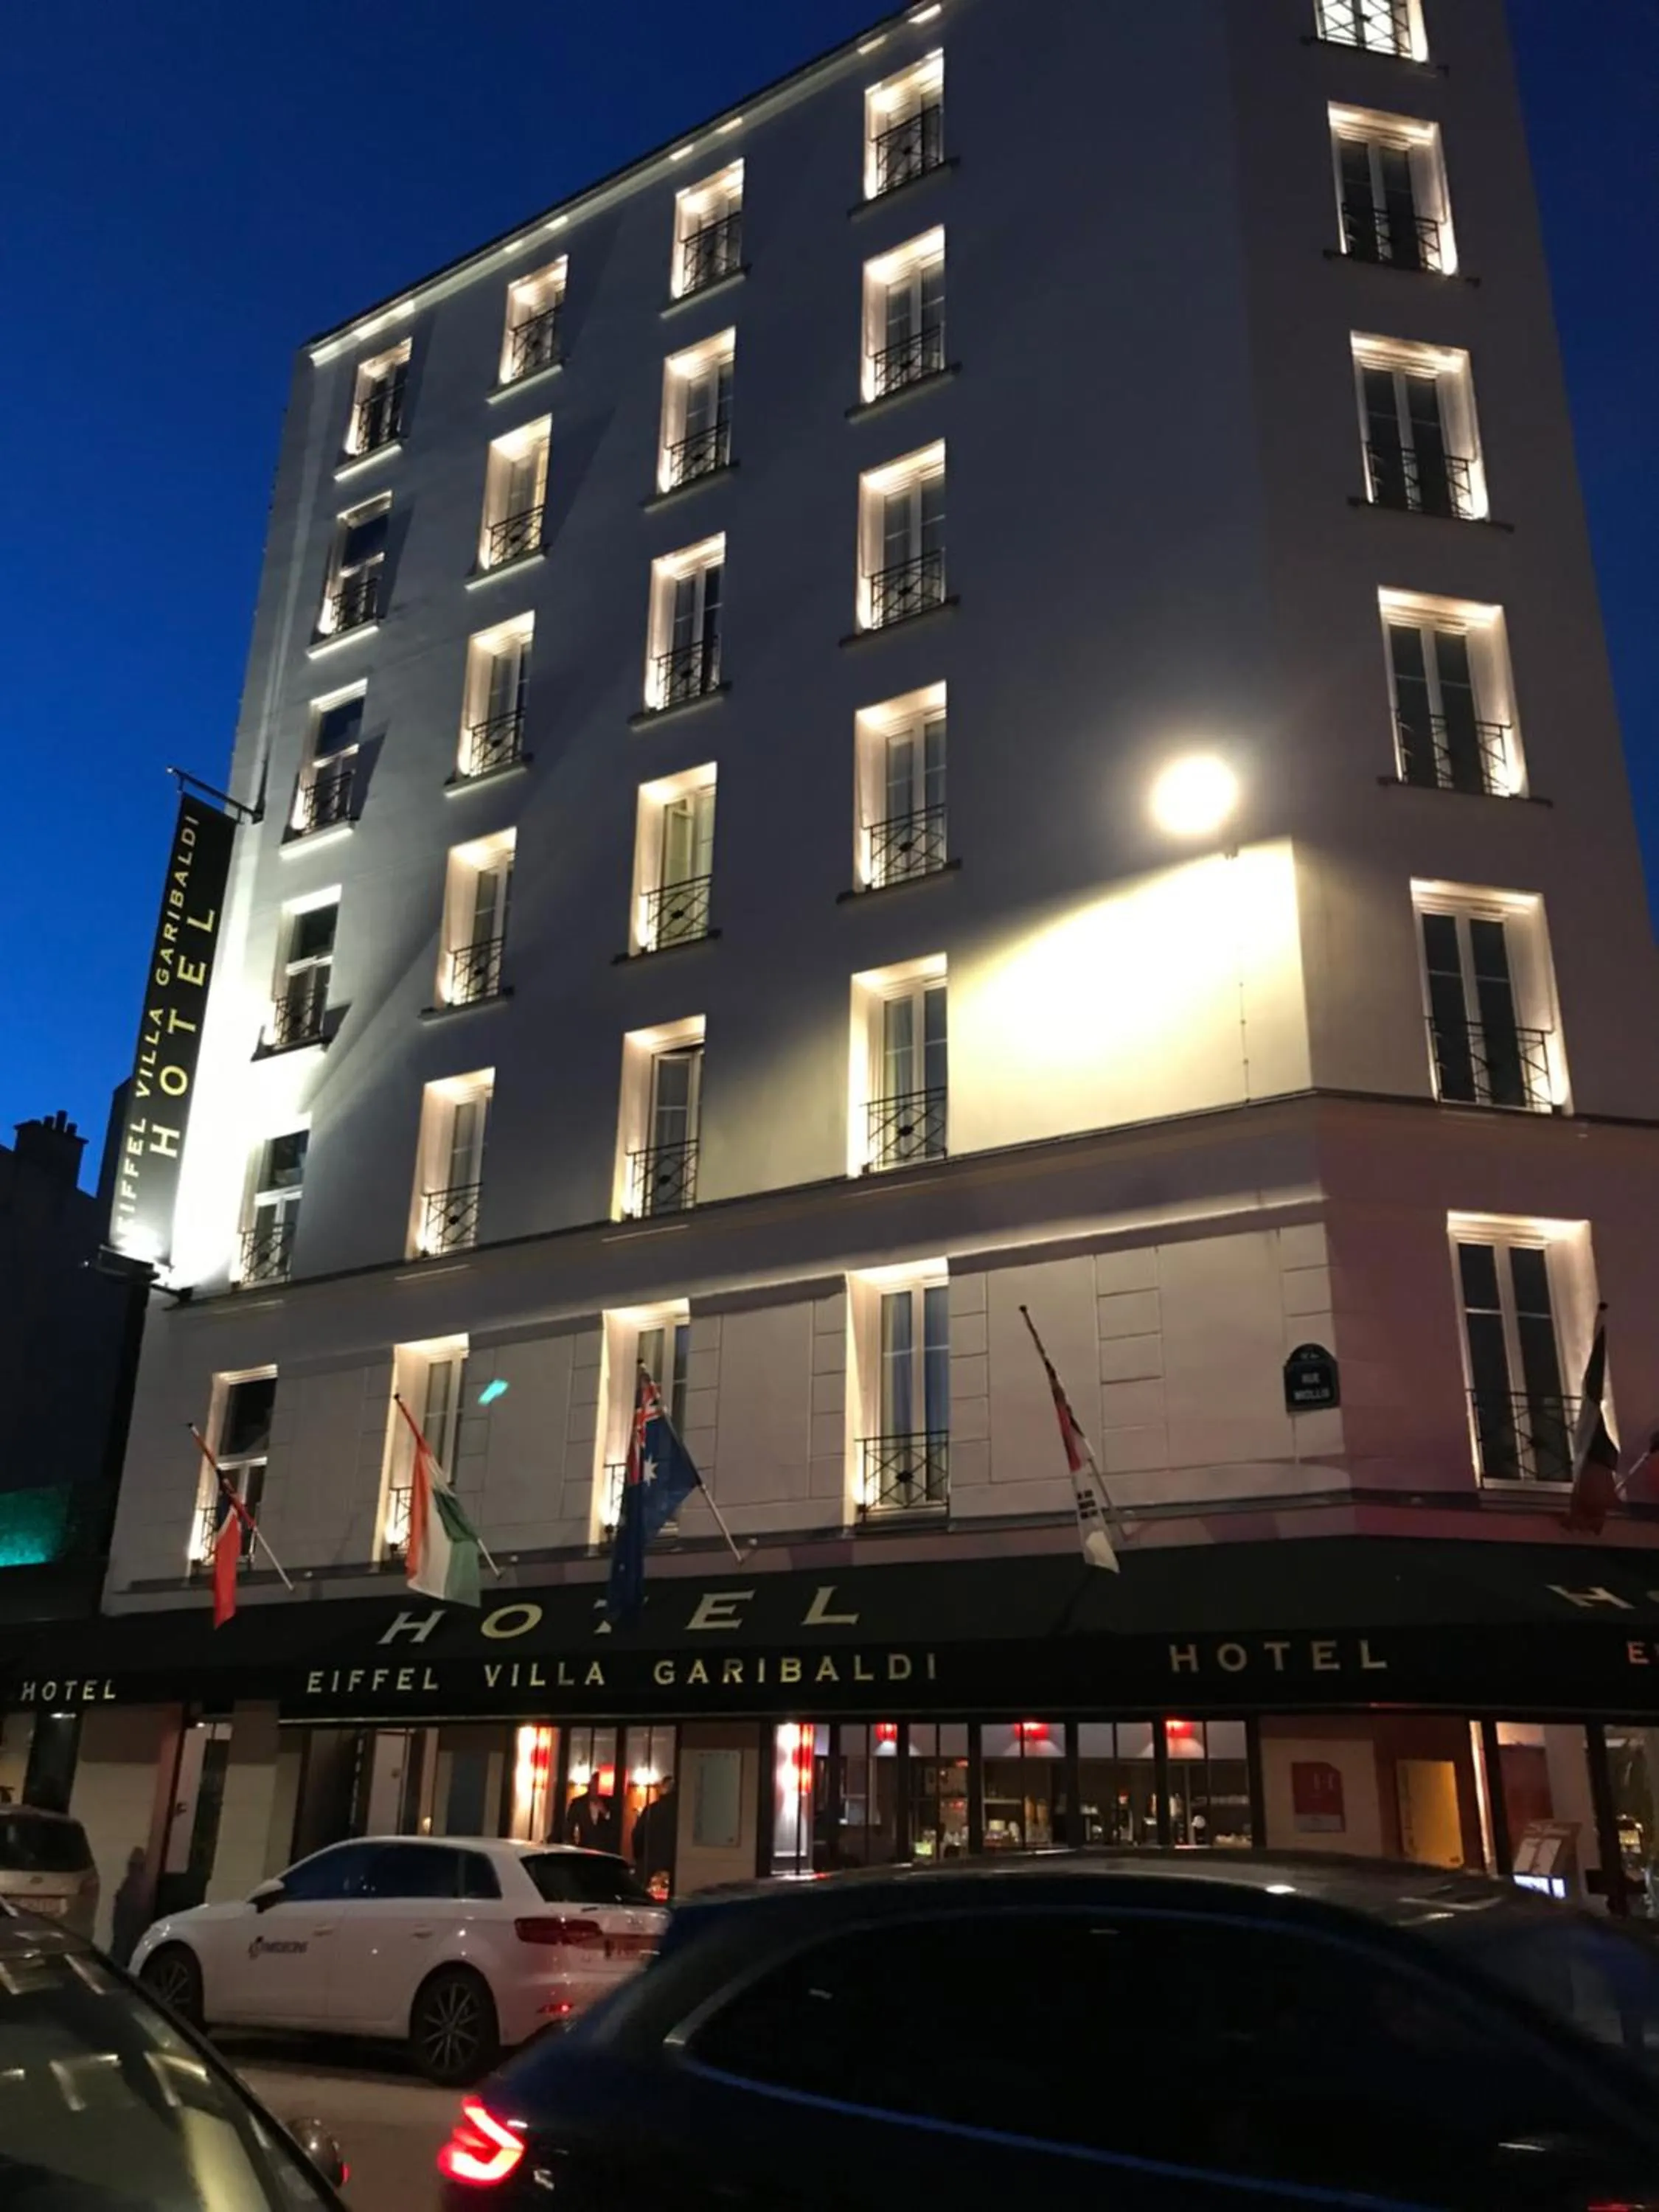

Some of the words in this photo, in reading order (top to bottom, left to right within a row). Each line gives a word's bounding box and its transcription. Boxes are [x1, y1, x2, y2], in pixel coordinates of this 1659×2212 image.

[135, 1008, 164, 1098] VILLA
[155, 815, 200, 986] GARIBALDI
[149, 908, 216, 1159] HOTEL
[377, 1585, 861, 1646] HOEL
[306, 1666, 441, 1694] EIFFEL
[484, 1660, 606, 1688] VILLA
[653, 1652, 936, 1686] GARIBALDI
[1169, 1639, 1388, 1673] HOTEL
[19, 1678, 116, 1702] HOTEL
